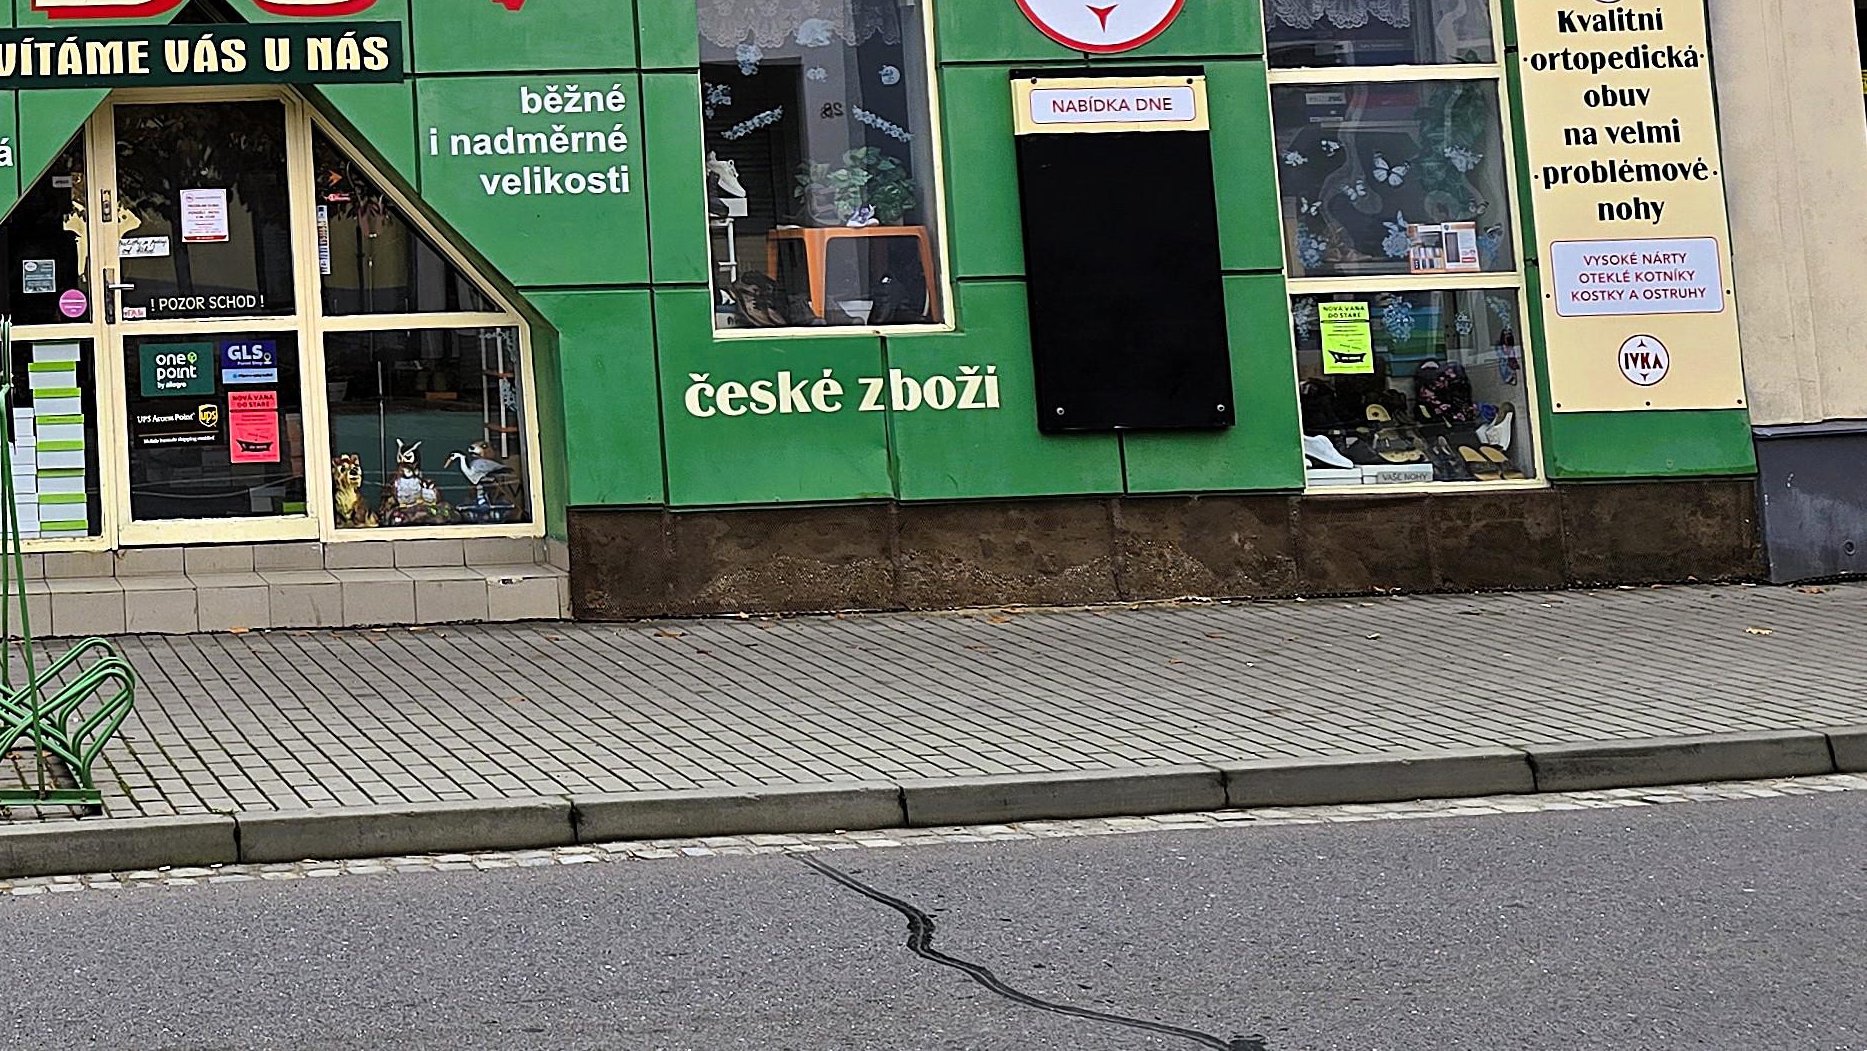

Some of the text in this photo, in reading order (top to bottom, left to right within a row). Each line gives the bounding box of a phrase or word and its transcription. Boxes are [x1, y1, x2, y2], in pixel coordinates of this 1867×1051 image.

[1558, 7, 1664, 33] Kvalitní
[164, 32, 247, 73] VÁS
[264, 37, 290, 71] U
[306, 31, 389, 71] NÁS
[1530, 44, 1699, 74] ortopedická
[520, 84, 626, 114] běžné
[1052, 96, 1173, 113] NABÍDKA DNE
[1583, 84, 1650, 108] obuv
[429, 124, 628, 156] i nadměrné
[1564, 118, 1681, 145] na velmi
[479, 165, 630, 195] velikosti
[1542, 157, 1709, 189] problémové
[1598, 197, 1665, 225] nohy
[1583, 251, 1687, 266] VYSOKÉ NÁRTY
[1579, 268, 1695, 284] OTEKLÉ KOTNÍKY
[150, 294, 265, 311] ! POZOR SCHOD !
[1571, 288, 1706, 302] KOSTKY A OSTRUHY
[155, 353, 187, 366] one
[227, 344, 263, 360] GLS
[1624, 352, 1664, 370] IVKA
[156, 365, 197, 381] point
[684, 365, 1000, 417] české zboží
[137, 415, 151, 423] UPS
